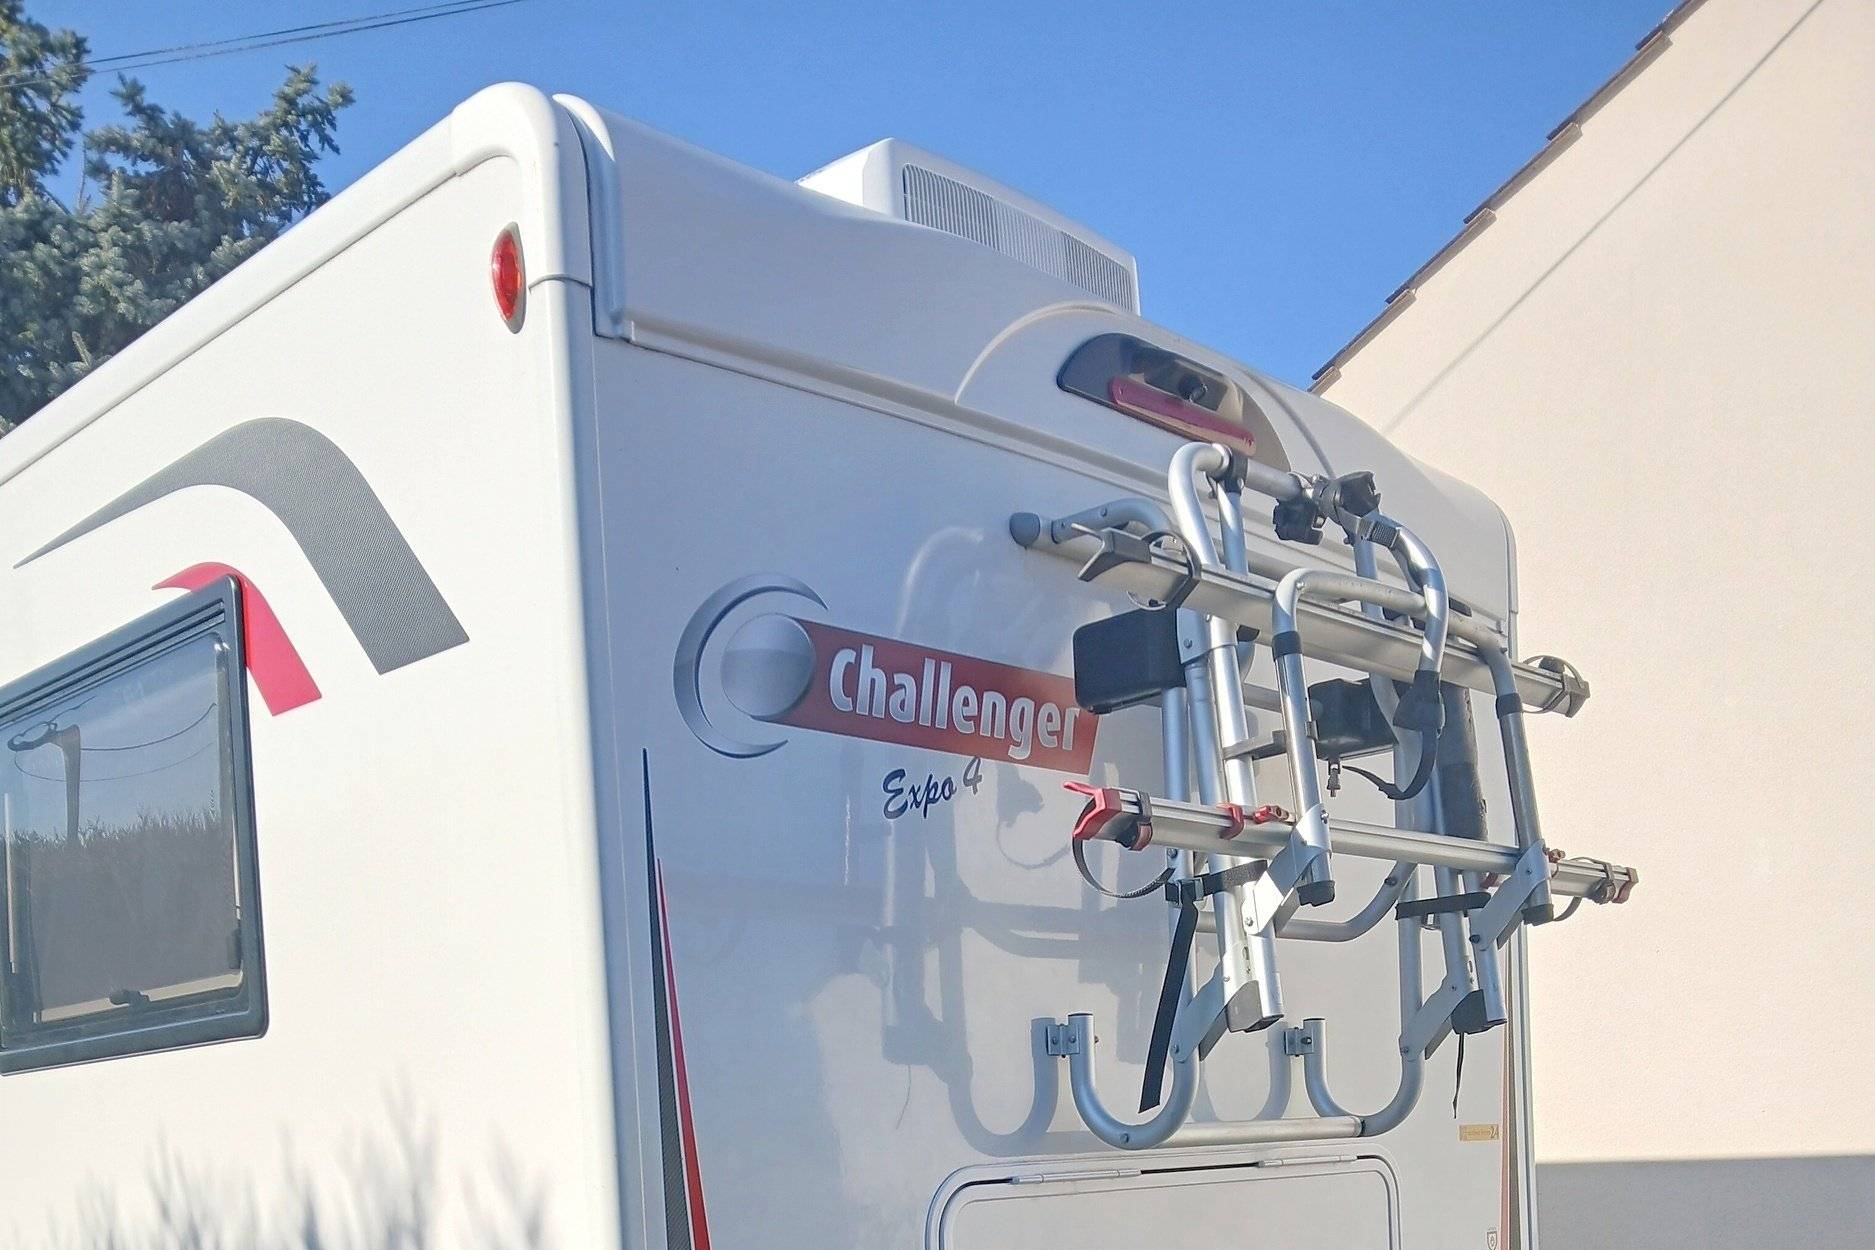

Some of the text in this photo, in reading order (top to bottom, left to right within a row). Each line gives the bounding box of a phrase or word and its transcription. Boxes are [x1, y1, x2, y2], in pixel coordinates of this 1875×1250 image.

[829, 644, 1081, 760] Challenger
[882, 757, 983, 819] Expo 4
